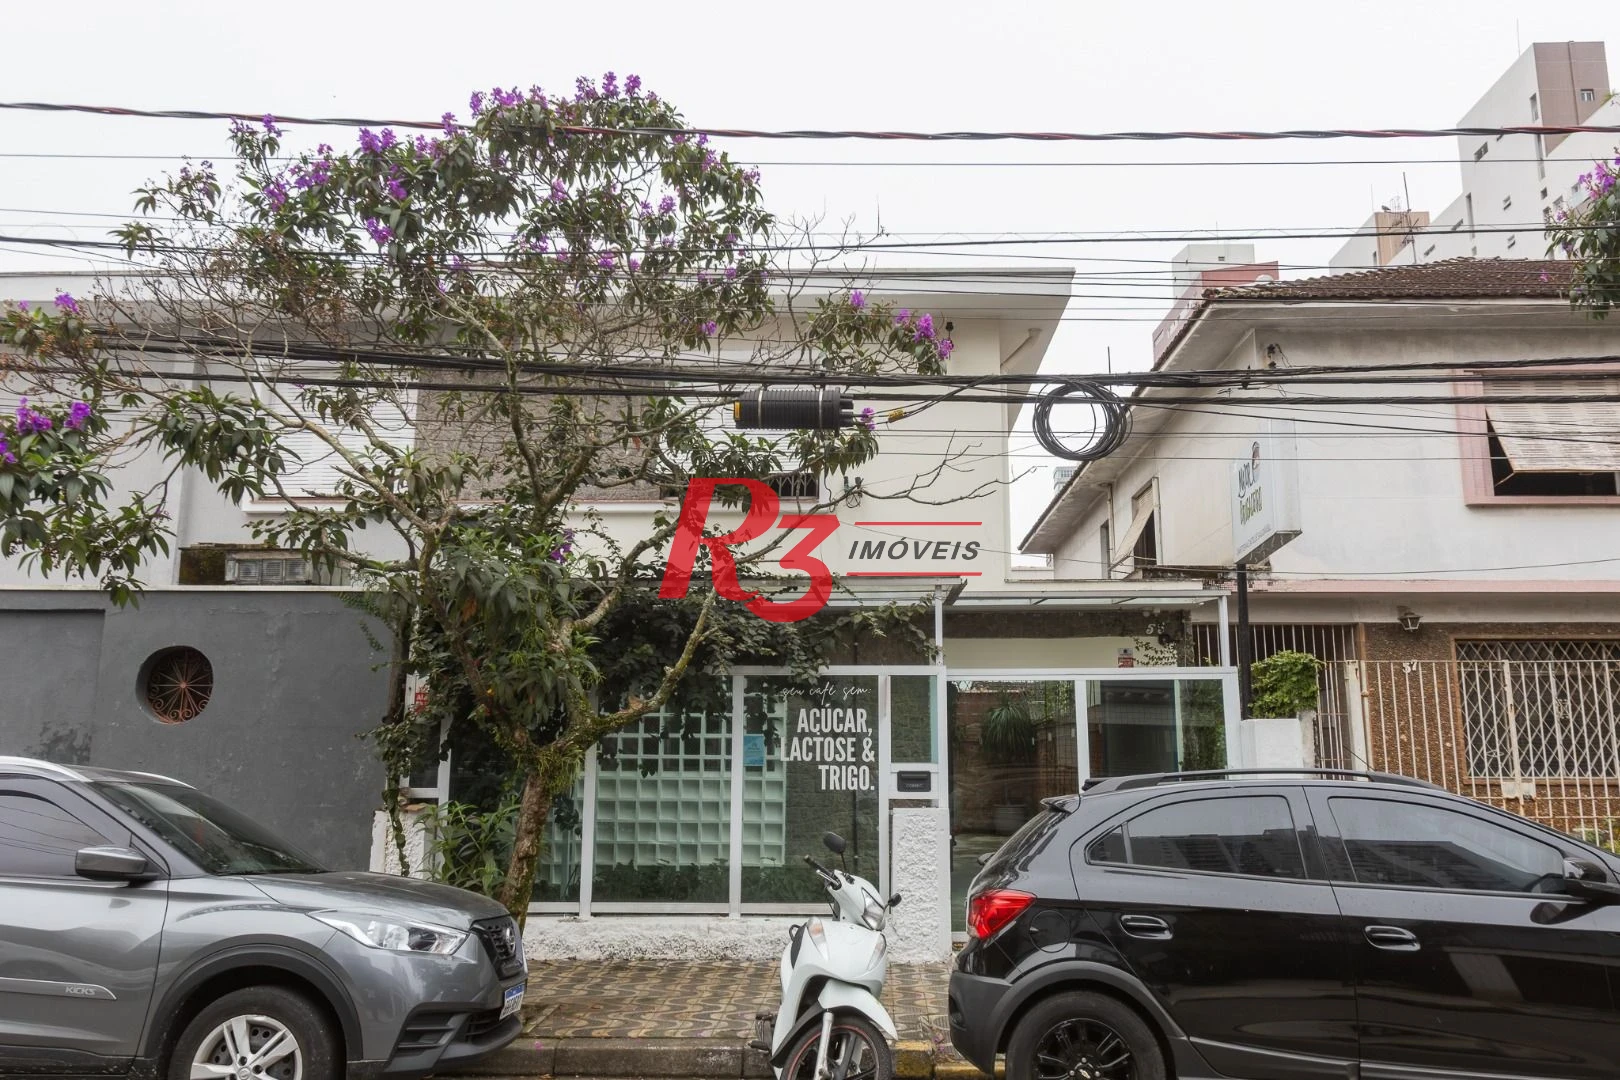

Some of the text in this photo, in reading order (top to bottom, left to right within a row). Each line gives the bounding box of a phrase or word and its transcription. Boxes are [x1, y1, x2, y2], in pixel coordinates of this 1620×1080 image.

[797, 703, 873, 737] AÇÚCAR,
[780, 736, 876, 762] LACTOSE &
[818, 765, 875, 791] TRIGO.
